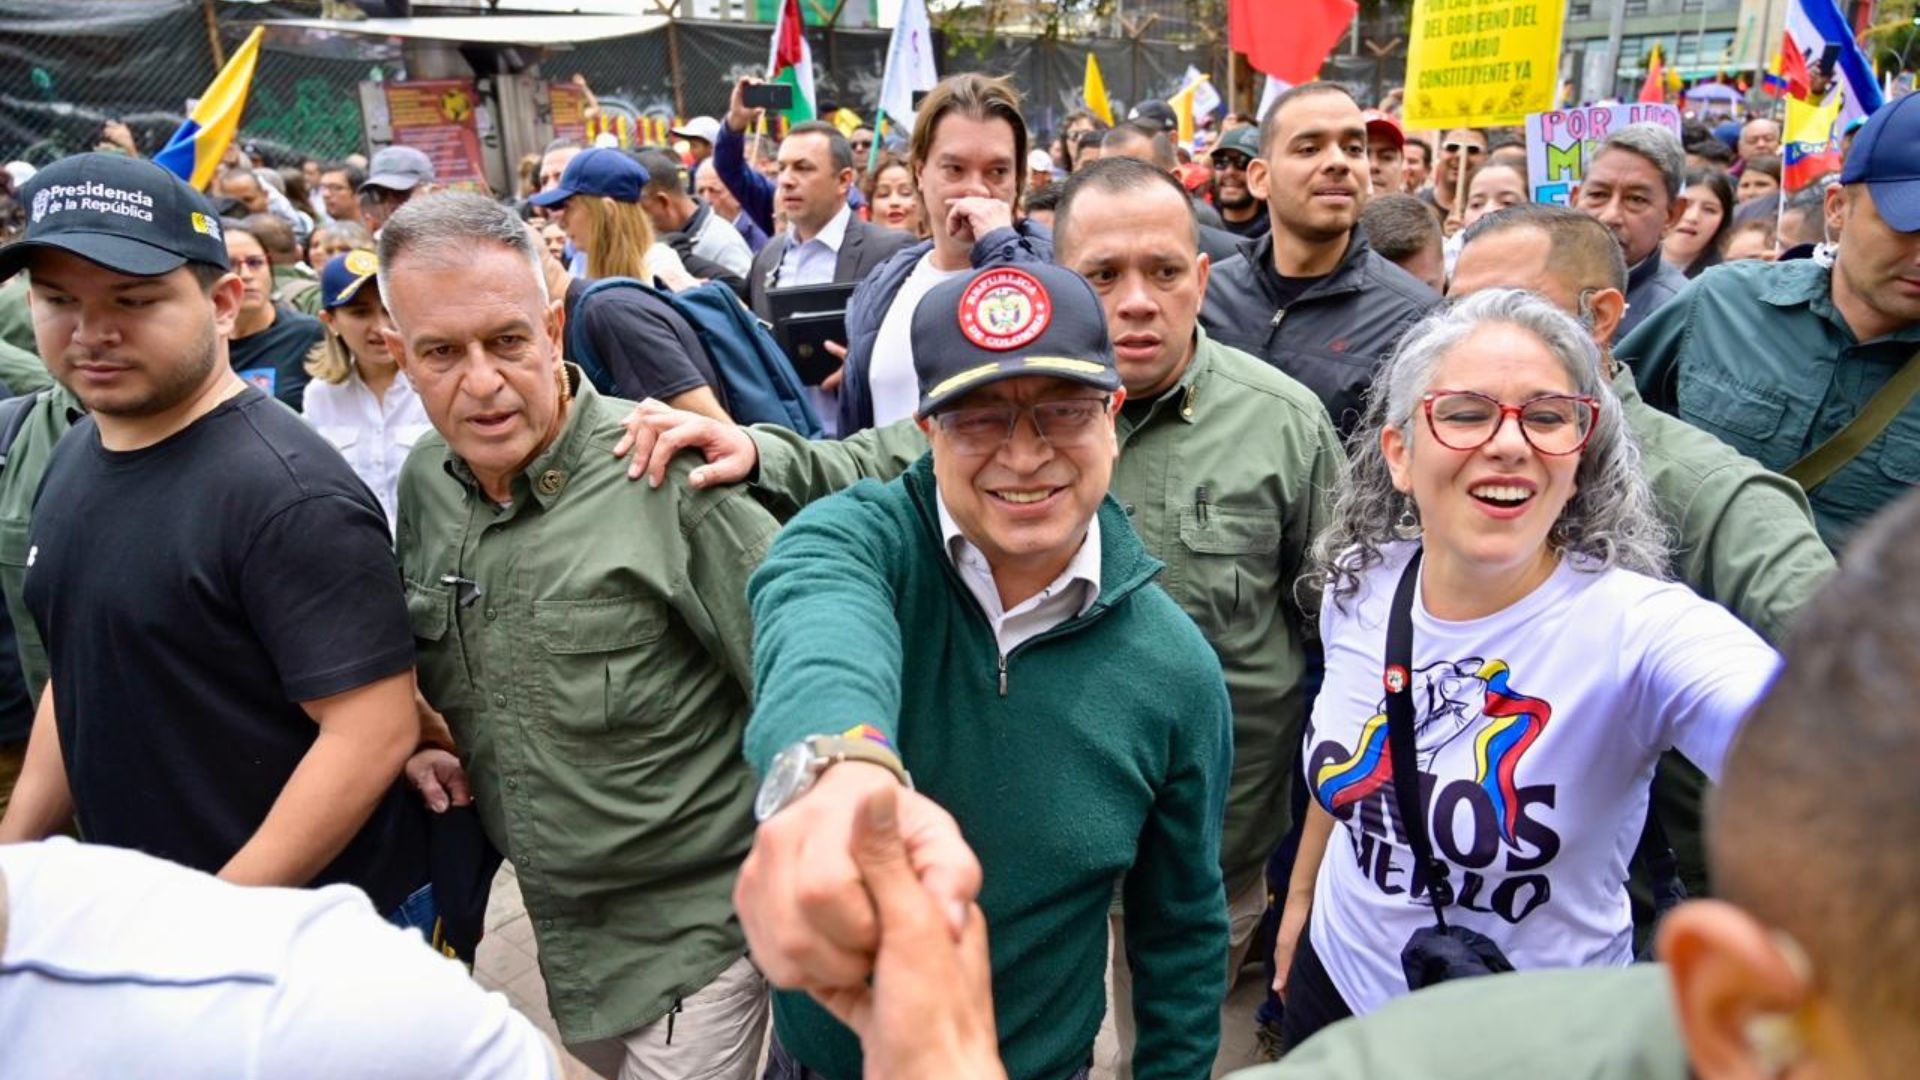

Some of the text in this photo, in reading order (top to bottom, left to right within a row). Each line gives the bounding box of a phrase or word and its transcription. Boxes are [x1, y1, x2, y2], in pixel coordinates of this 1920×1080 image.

[1423, 4, 1538, 40] DEL GOBIERNO DEL
[1449, 36, 1500, 61] CAMBIO
[1418, 59, 1533, 90] CONSTITUYENTE YA
[1541, 107, 1612, 143] POR
[51, 181, 153, 207] Presidencia
[50, 198, 153, 222] de la República
